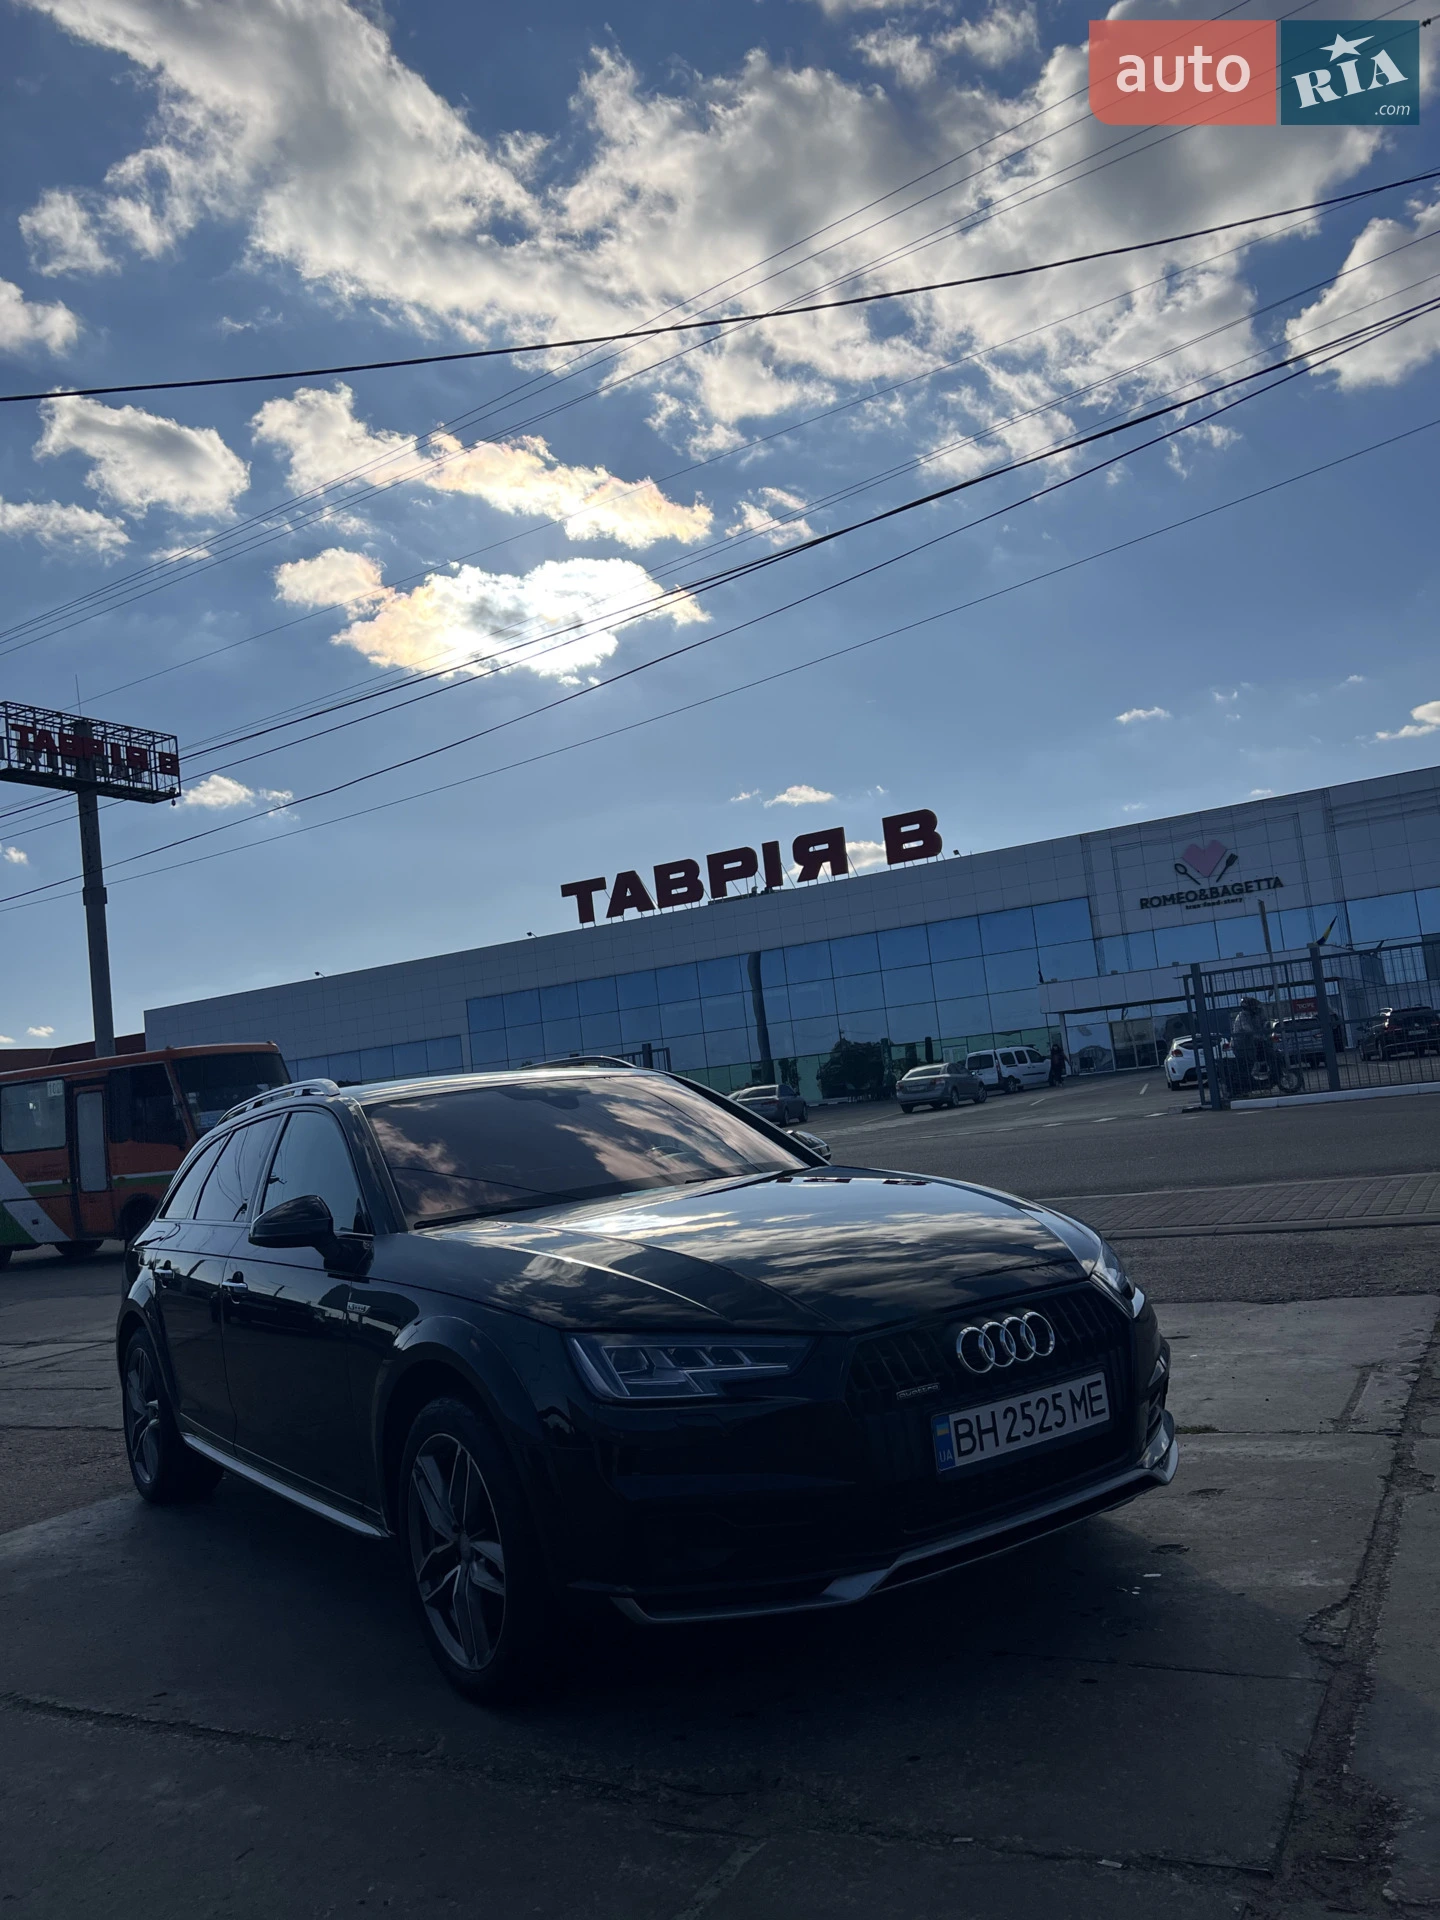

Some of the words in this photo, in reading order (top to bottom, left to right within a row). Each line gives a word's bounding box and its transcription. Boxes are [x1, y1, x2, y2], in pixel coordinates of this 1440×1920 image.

[560, 826, 849, 924] ТАВРІЯ
[882, 808, 943, 865] В
[1139, 876, 1284, 910] ROMEO&BAGETTA
[953, 1410, 999, 1458] BH
[1003, 1392, 1067, 1444] 2525
[1069, 1380, 1106, 1424] ME
[938, 1450, 953, 1463] UA
